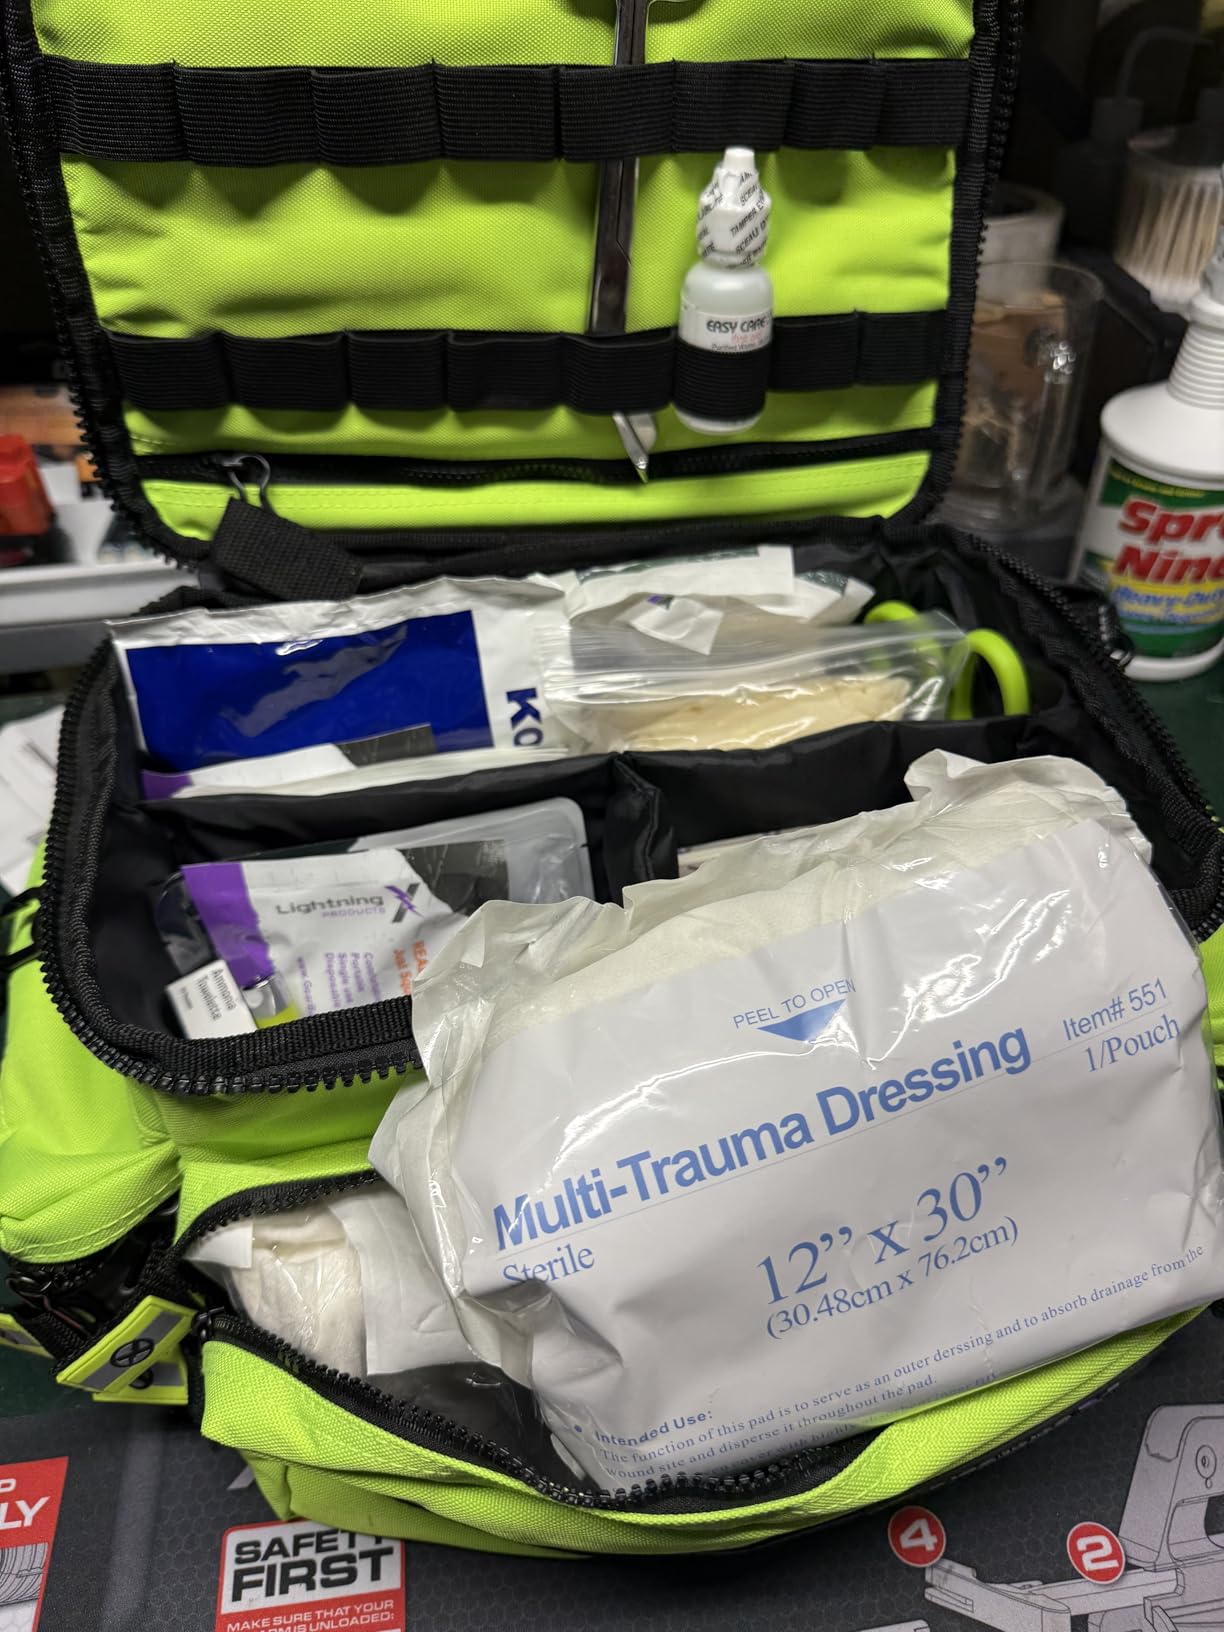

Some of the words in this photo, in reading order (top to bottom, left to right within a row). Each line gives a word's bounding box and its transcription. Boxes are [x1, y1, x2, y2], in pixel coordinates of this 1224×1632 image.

[706, 320, 738, 334] EASY
[740, 316, 767, 333] CARE
[276, 895, 384, 915] Lightning
[321, 906, 386, 918] PRODUCTS
[196, 975, 222, 1021] Towelette
[212, 968, 237, 1011] Ammonia
[733, 1007, 780, 1029] PEEL
[781, 994, 807, 1014] TO
[810, 979, 857, 1002] OPEN
[1063, 996, 1126, 1041] Item#
[1128, 977, 1167, 1012] 551
[1084, 1013, 1181, 1072] 1/Pouch
[493, 1112, 815, 1251] Multi-Trauma
[816, 1027, 1032, 1136] Dressing
[502, 1243, 596, 1284] Sterile
[766, 1279, 893, 1341] (30.48cm
[896, 1269, 915, 1291] x
[917, 1215, 1020, 1278] 76.2cm)
[632, 1436, 696, 1464] function
[699, 1428, 715, 1443] of
[717, 1421, 745, 1438] this
[749, 1408, 776, 1431] pad
[778, 1405, 792, 1418] is
[795, 1401, 809, 1414] to
[812, 1386, 852, 1408] serve
[855, 1381, 871, 1394] as
[874, 1373, 891, 1387] an
[894, 1356, 930, 1379] outer
[933, 1332, 995, 1363] derssing
[996, 1320, 1022, 1340] and
[1024, 1315, 1038, 1329] to
[1041, 1295, 1088, 1322] absorb
[1090, 1271, 1150, 1303] drainage
[1151, 1260, 1186, 1278] from
[1187, 1245, 1204, 1265] the
[595, 1421, 670, 1446] Intended
[673, 1410, 714, 1430] Use:
[658, 1459, 685, 1474] site
[689, 1447, 716, 1464] and
[719, 1426, 781, 1454] disperse
[783, 1423, 794, 1434] it
[797, 1396, 879, 1428] throughout
[881, 1388, 904, 1402] the
[907, 1374, 938, 1396] pad.
[900, 1518, 938, 1552] 4
[1076, 1534, 1120, 1572] 2
[231, 1546, 394, 1603] FIRST
[227, 1617, 271, 1632] MAKE
[272, 1611, 313, 1626] SURE
[315, 1605, 352, 1620] THAT
[353, 1599, 394, 1613] YOUR
